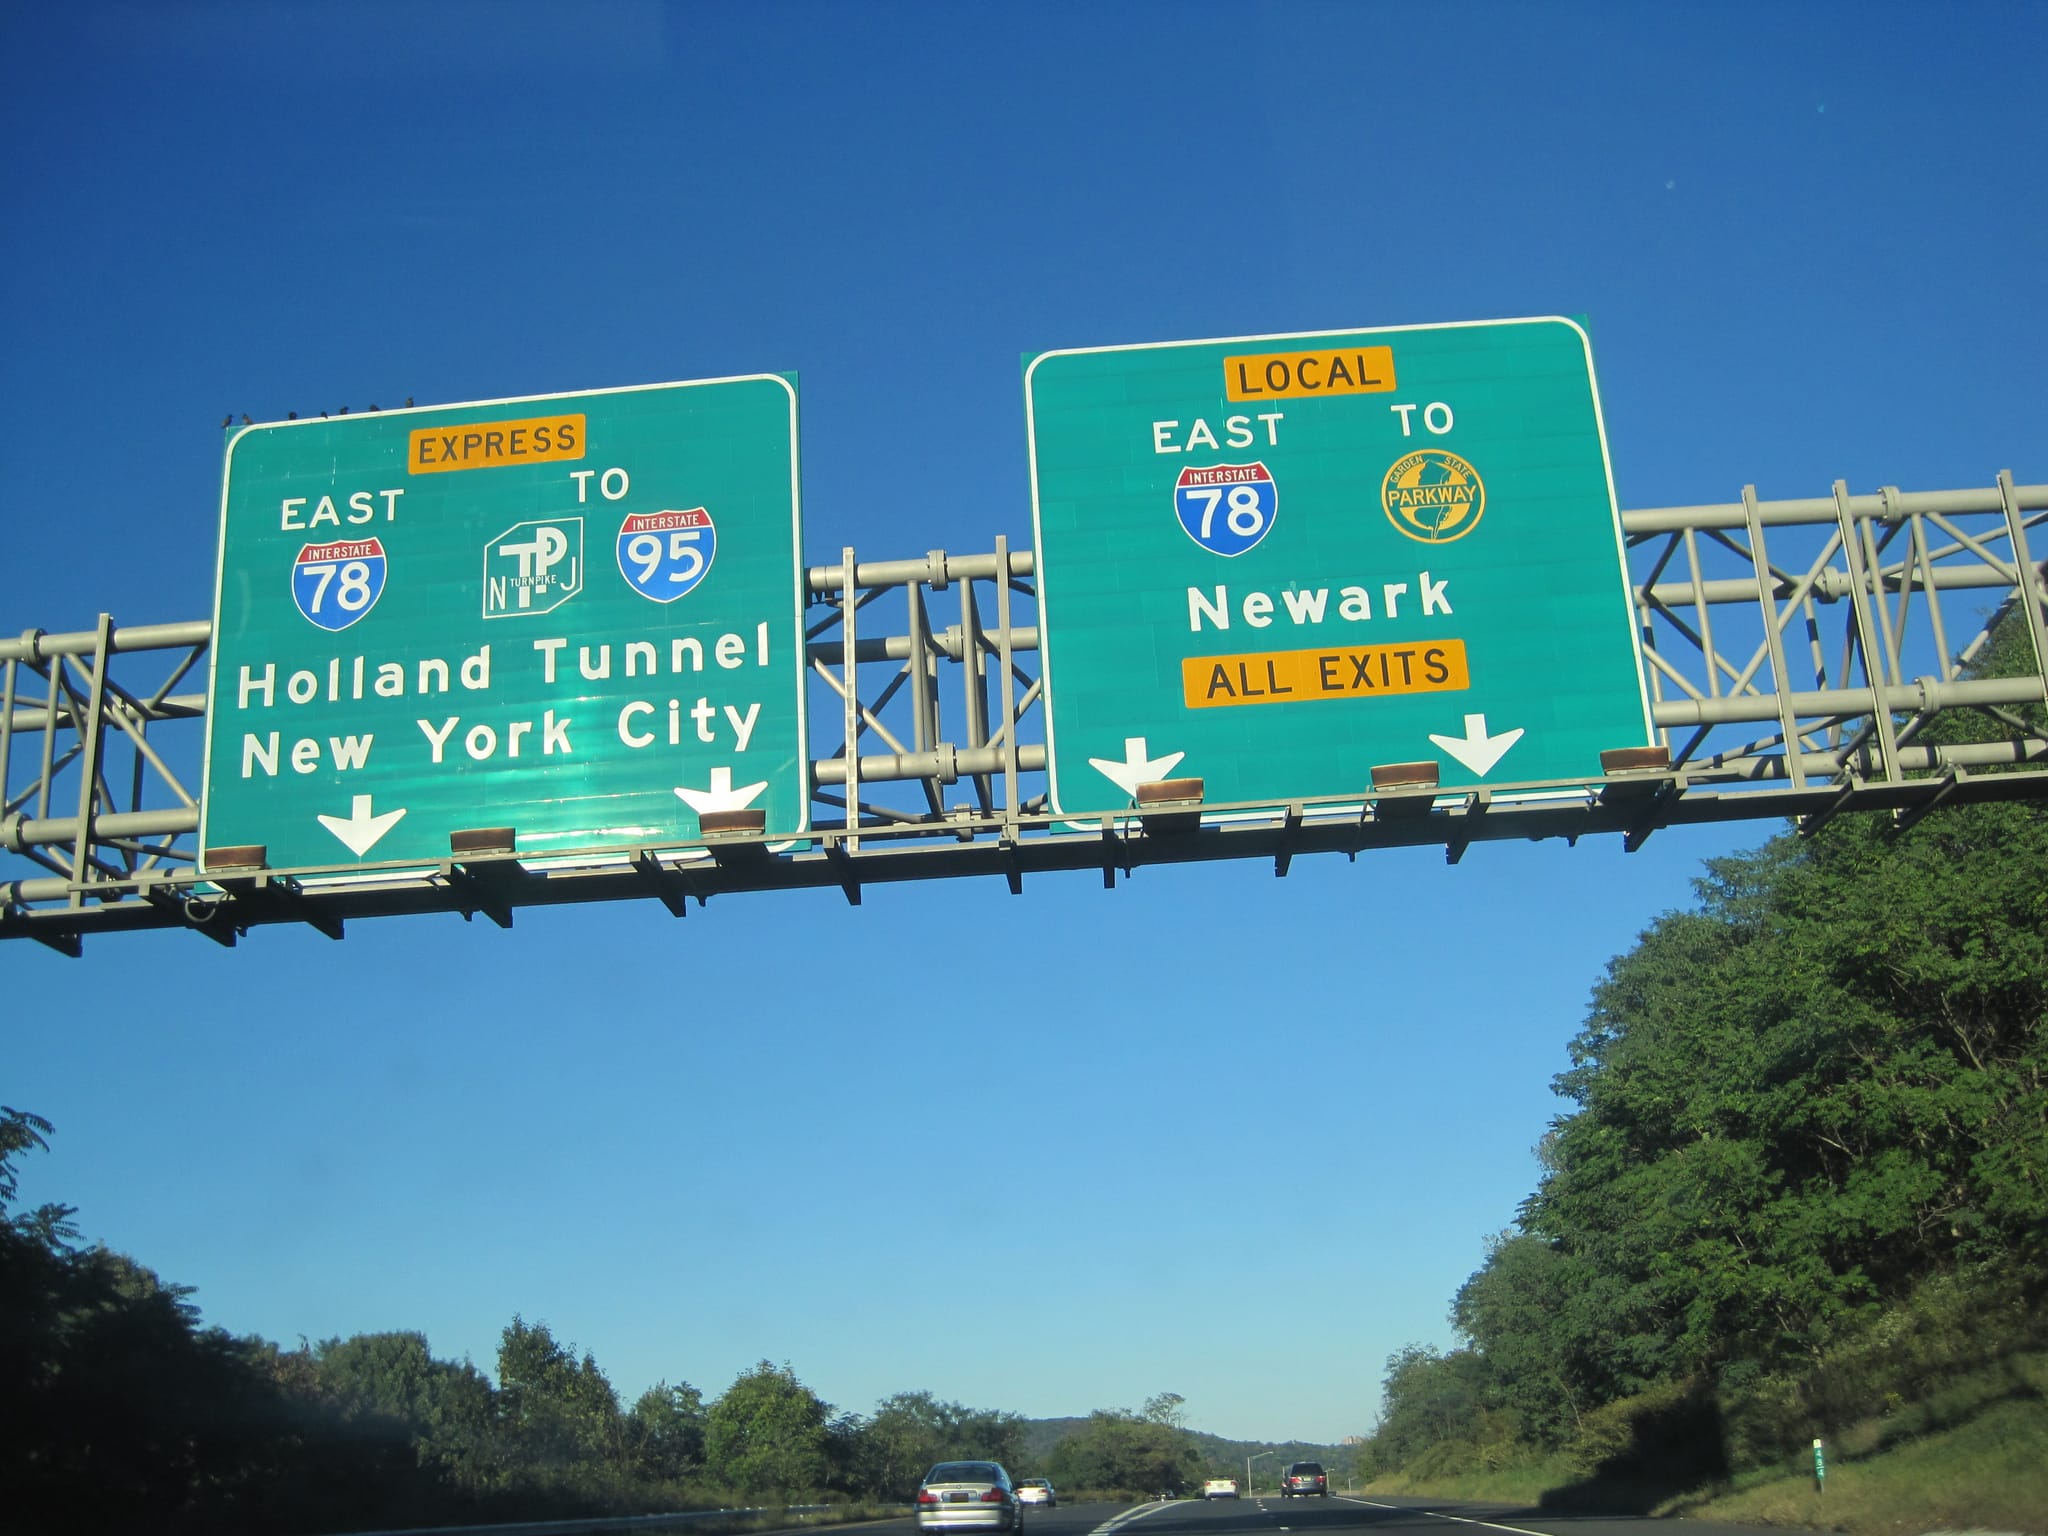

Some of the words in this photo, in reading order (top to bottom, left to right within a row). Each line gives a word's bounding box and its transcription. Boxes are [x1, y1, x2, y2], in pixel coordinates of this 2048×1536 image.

[1239, 354, 1382, 394] LOCAL
[1153, 413, 1284, 454] EAST
[1390, 402, 1454, 437] TO
[418, 423, 577, 464] EXPRESS
[570, 468, 629, 503] TO
[1188, 467, 1259, 483] INTERSTATE
[1390, 455, 1424, 483] GARDEN
[1444, 456, 1473, 479] STATE
[281, 489, 405, 531] EAST
[1185, 488, 1264, 538] 78
[1387, 485, 1477, 507] PARKWAY
[632, 512, 701, 531] INTERSTATE
[307, 543, 373, 561] INTERSTATE
[627, 531, 703, 583] 95
[303, 561, 371, 614] 78
[510, 573, 558, 589] TURNPIKE
[1187, 571, 1454, 632] Newark
[238, 644, 490, 709] Holland
[533, 621, 769, 684] Tunnel
[1206, 661, 1293, 700] ALL
[1319, 649, 1449, 691] EXITS
[241, 730, 374, 778] New
[417, 709, 573, 764] York
[618, 698, 761, 753] City
